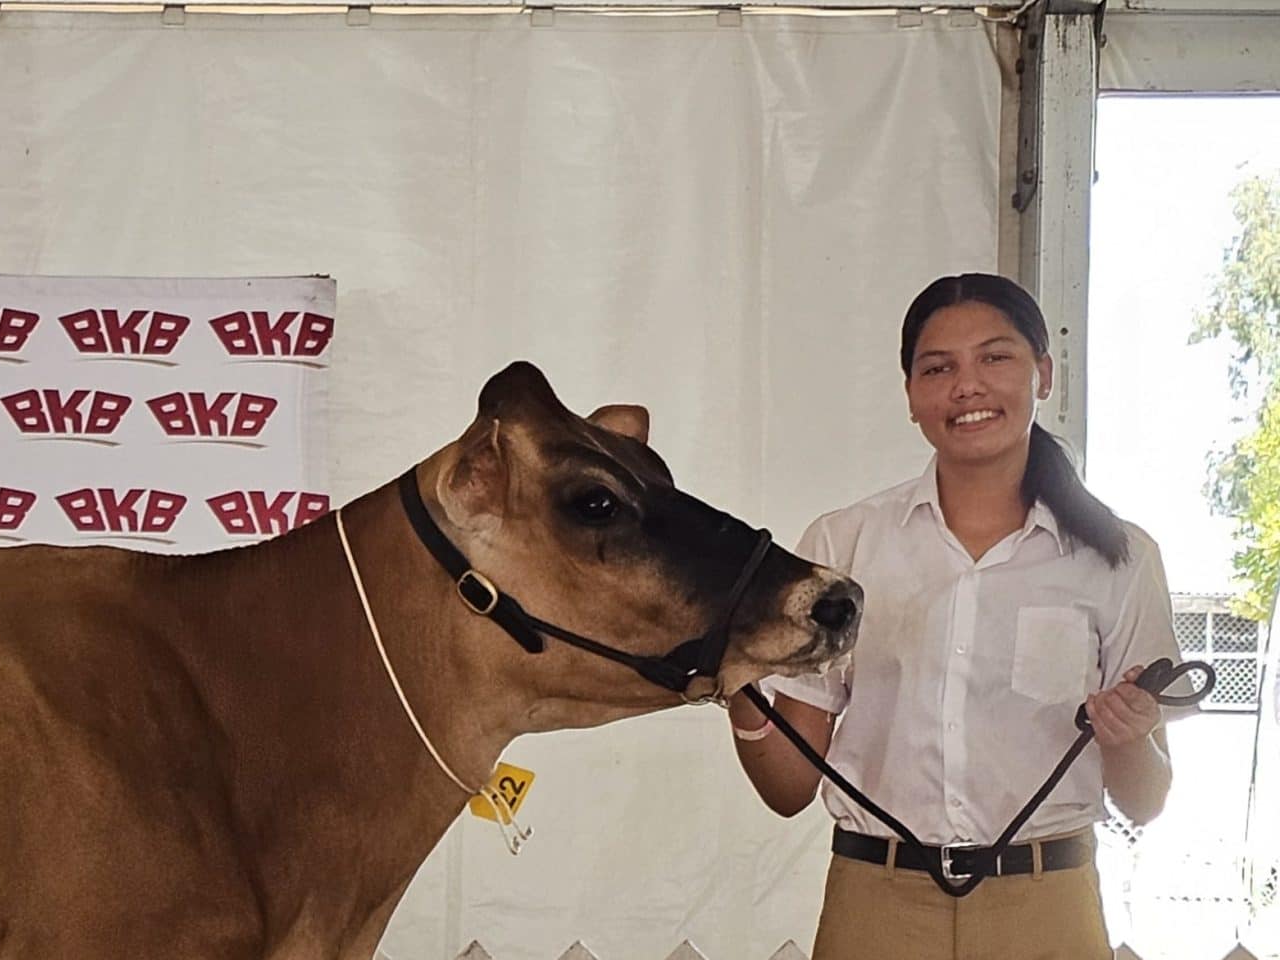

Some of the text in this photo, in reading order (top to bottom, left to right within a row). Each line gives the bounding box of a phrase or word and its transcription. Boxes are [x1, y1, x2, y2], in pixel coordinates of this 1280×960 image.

[59, 308, 190, 354] BKB
[206, 310, 335, 355] BKB
[0, 388, 132, 433] BKB
[146, 391, 277, 435] BKB
[55, 487, 187, 531] BKB
[203, 489, 331, 535] BKB
